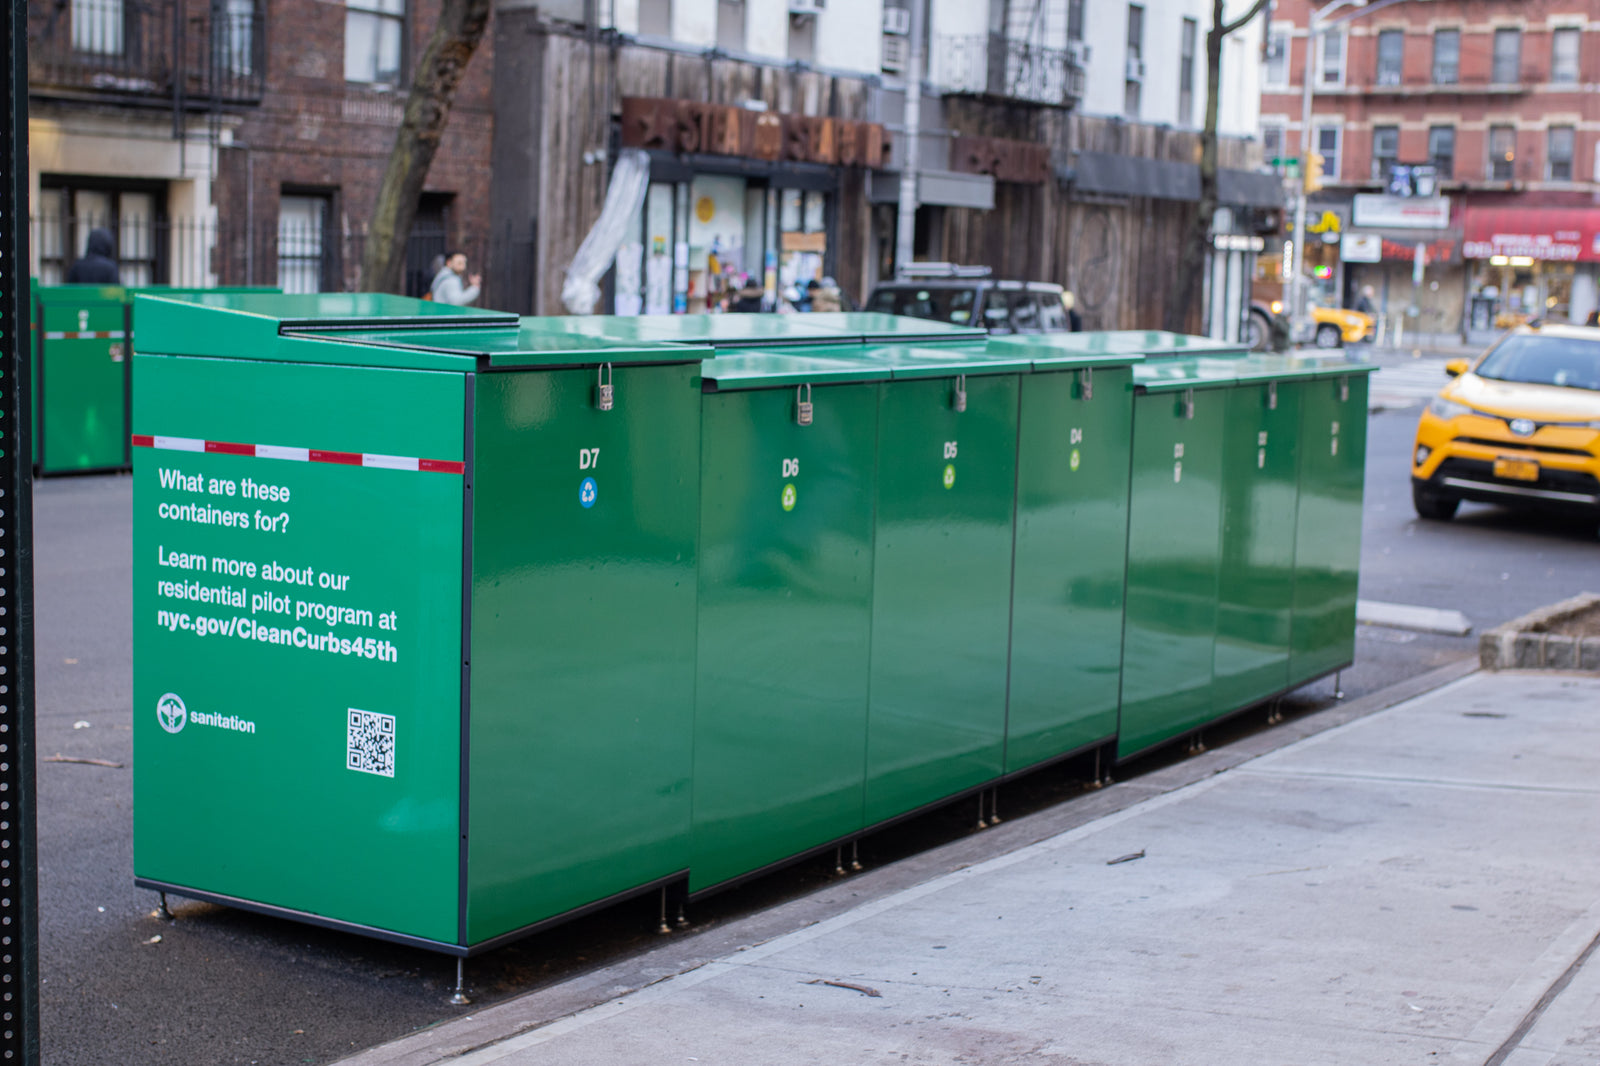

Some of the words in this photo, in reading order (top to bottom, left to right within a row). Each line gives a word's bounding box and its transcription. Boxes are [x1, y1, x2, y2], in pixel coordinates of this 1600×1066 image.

[1070, 427, 1082, 444] D4
[579, 448, 600, 470] D7
[943, 441, 957, 459] D5
[782, 457, 799, 478] D6
[158, 467, 204, 493] What
[208, 478, 236, 497] are
[240, 477, 290, 503] these
[158, 502, 250, 529] containers
[253, 509, 290, 533] for?
[158, 545, 207, 571] Learn
[211, 556, 257, 578] more
[261, 560, 314, 586] about
[318, 572, 350, 591] our
[157, 579, 247, 608] residential
[251, 591, 291, 615] pilot
[295, 600, 373, 627] program
[378, 610, 398, 631] at
[157, 609, 398, 663] nyc.gov/CleanCurbs45th
[190, 710, 256, 734] sanitation
